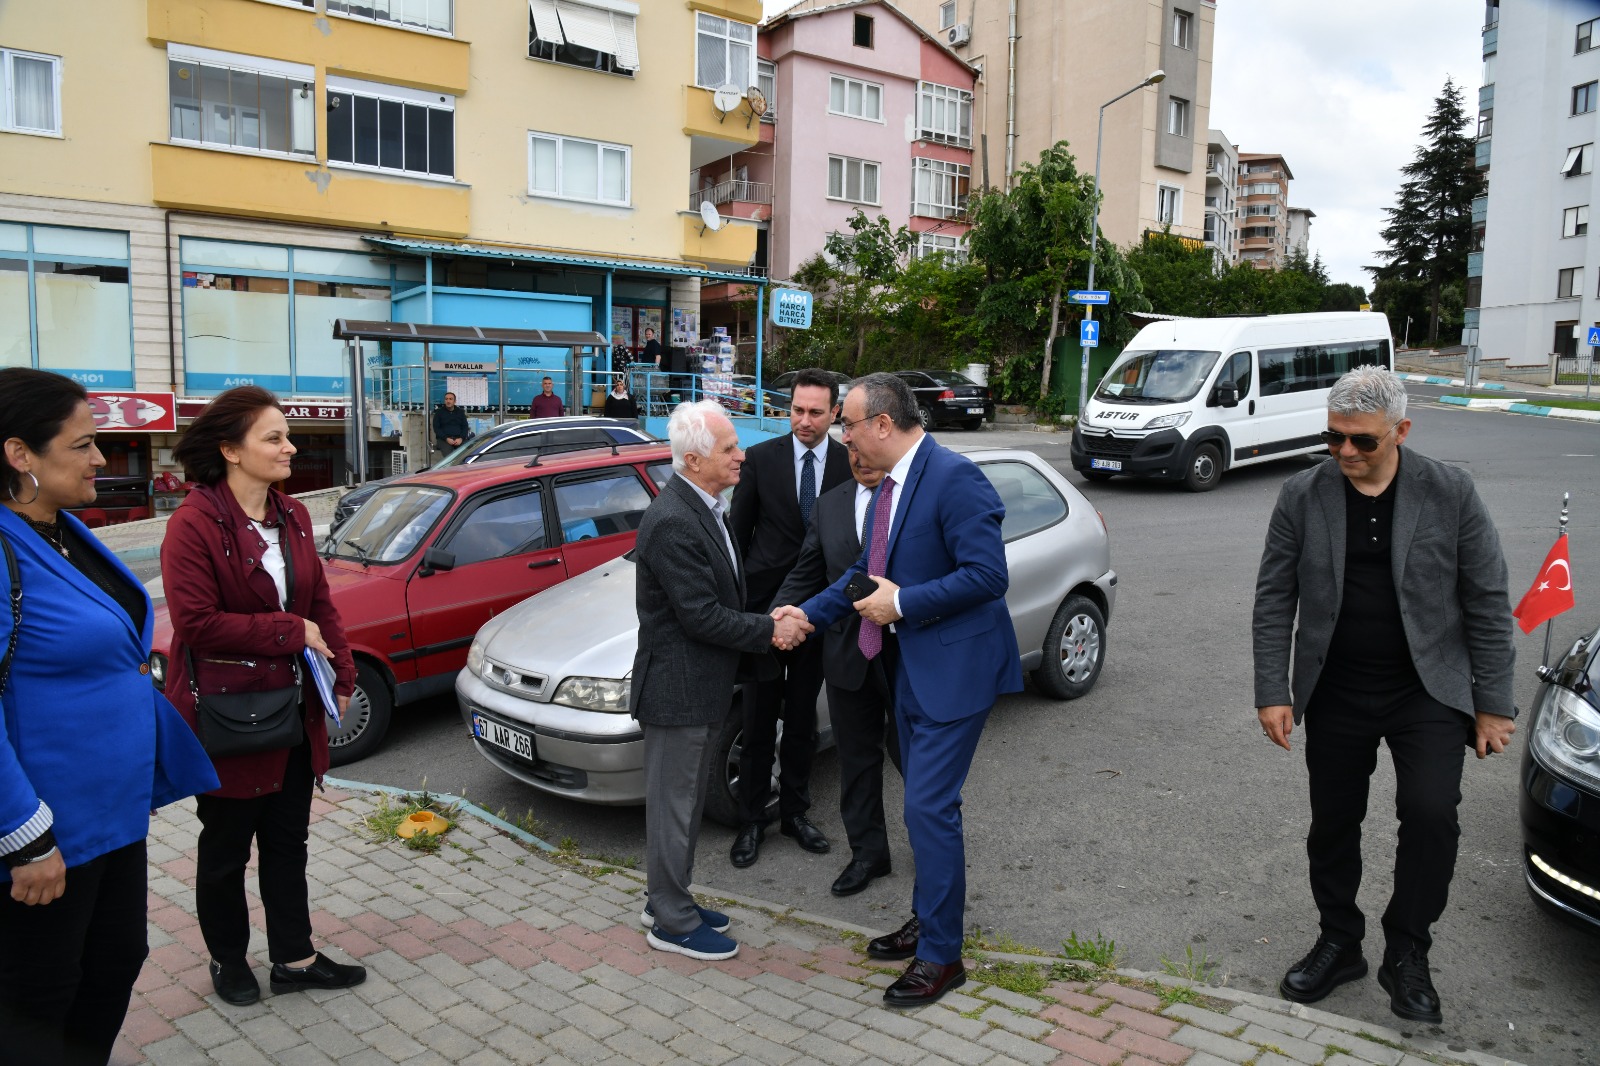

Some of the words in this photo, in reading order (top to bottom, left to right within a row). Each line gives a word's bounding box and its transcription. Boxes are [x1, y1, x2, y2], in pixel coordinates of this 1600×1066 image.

[779, 302, 806, 311] HARCA
[779, 309, 806, 319] HARCA
[444, 362, 484, 370] BAYKALLAR
[317, 407, 339, 418] ET
[1094, 411, 1140, 421] ASTUR
[479, 718, 488, 739] 67
[493, 724, 511, 749] AAR
[513, 732, 531, 757] 266
